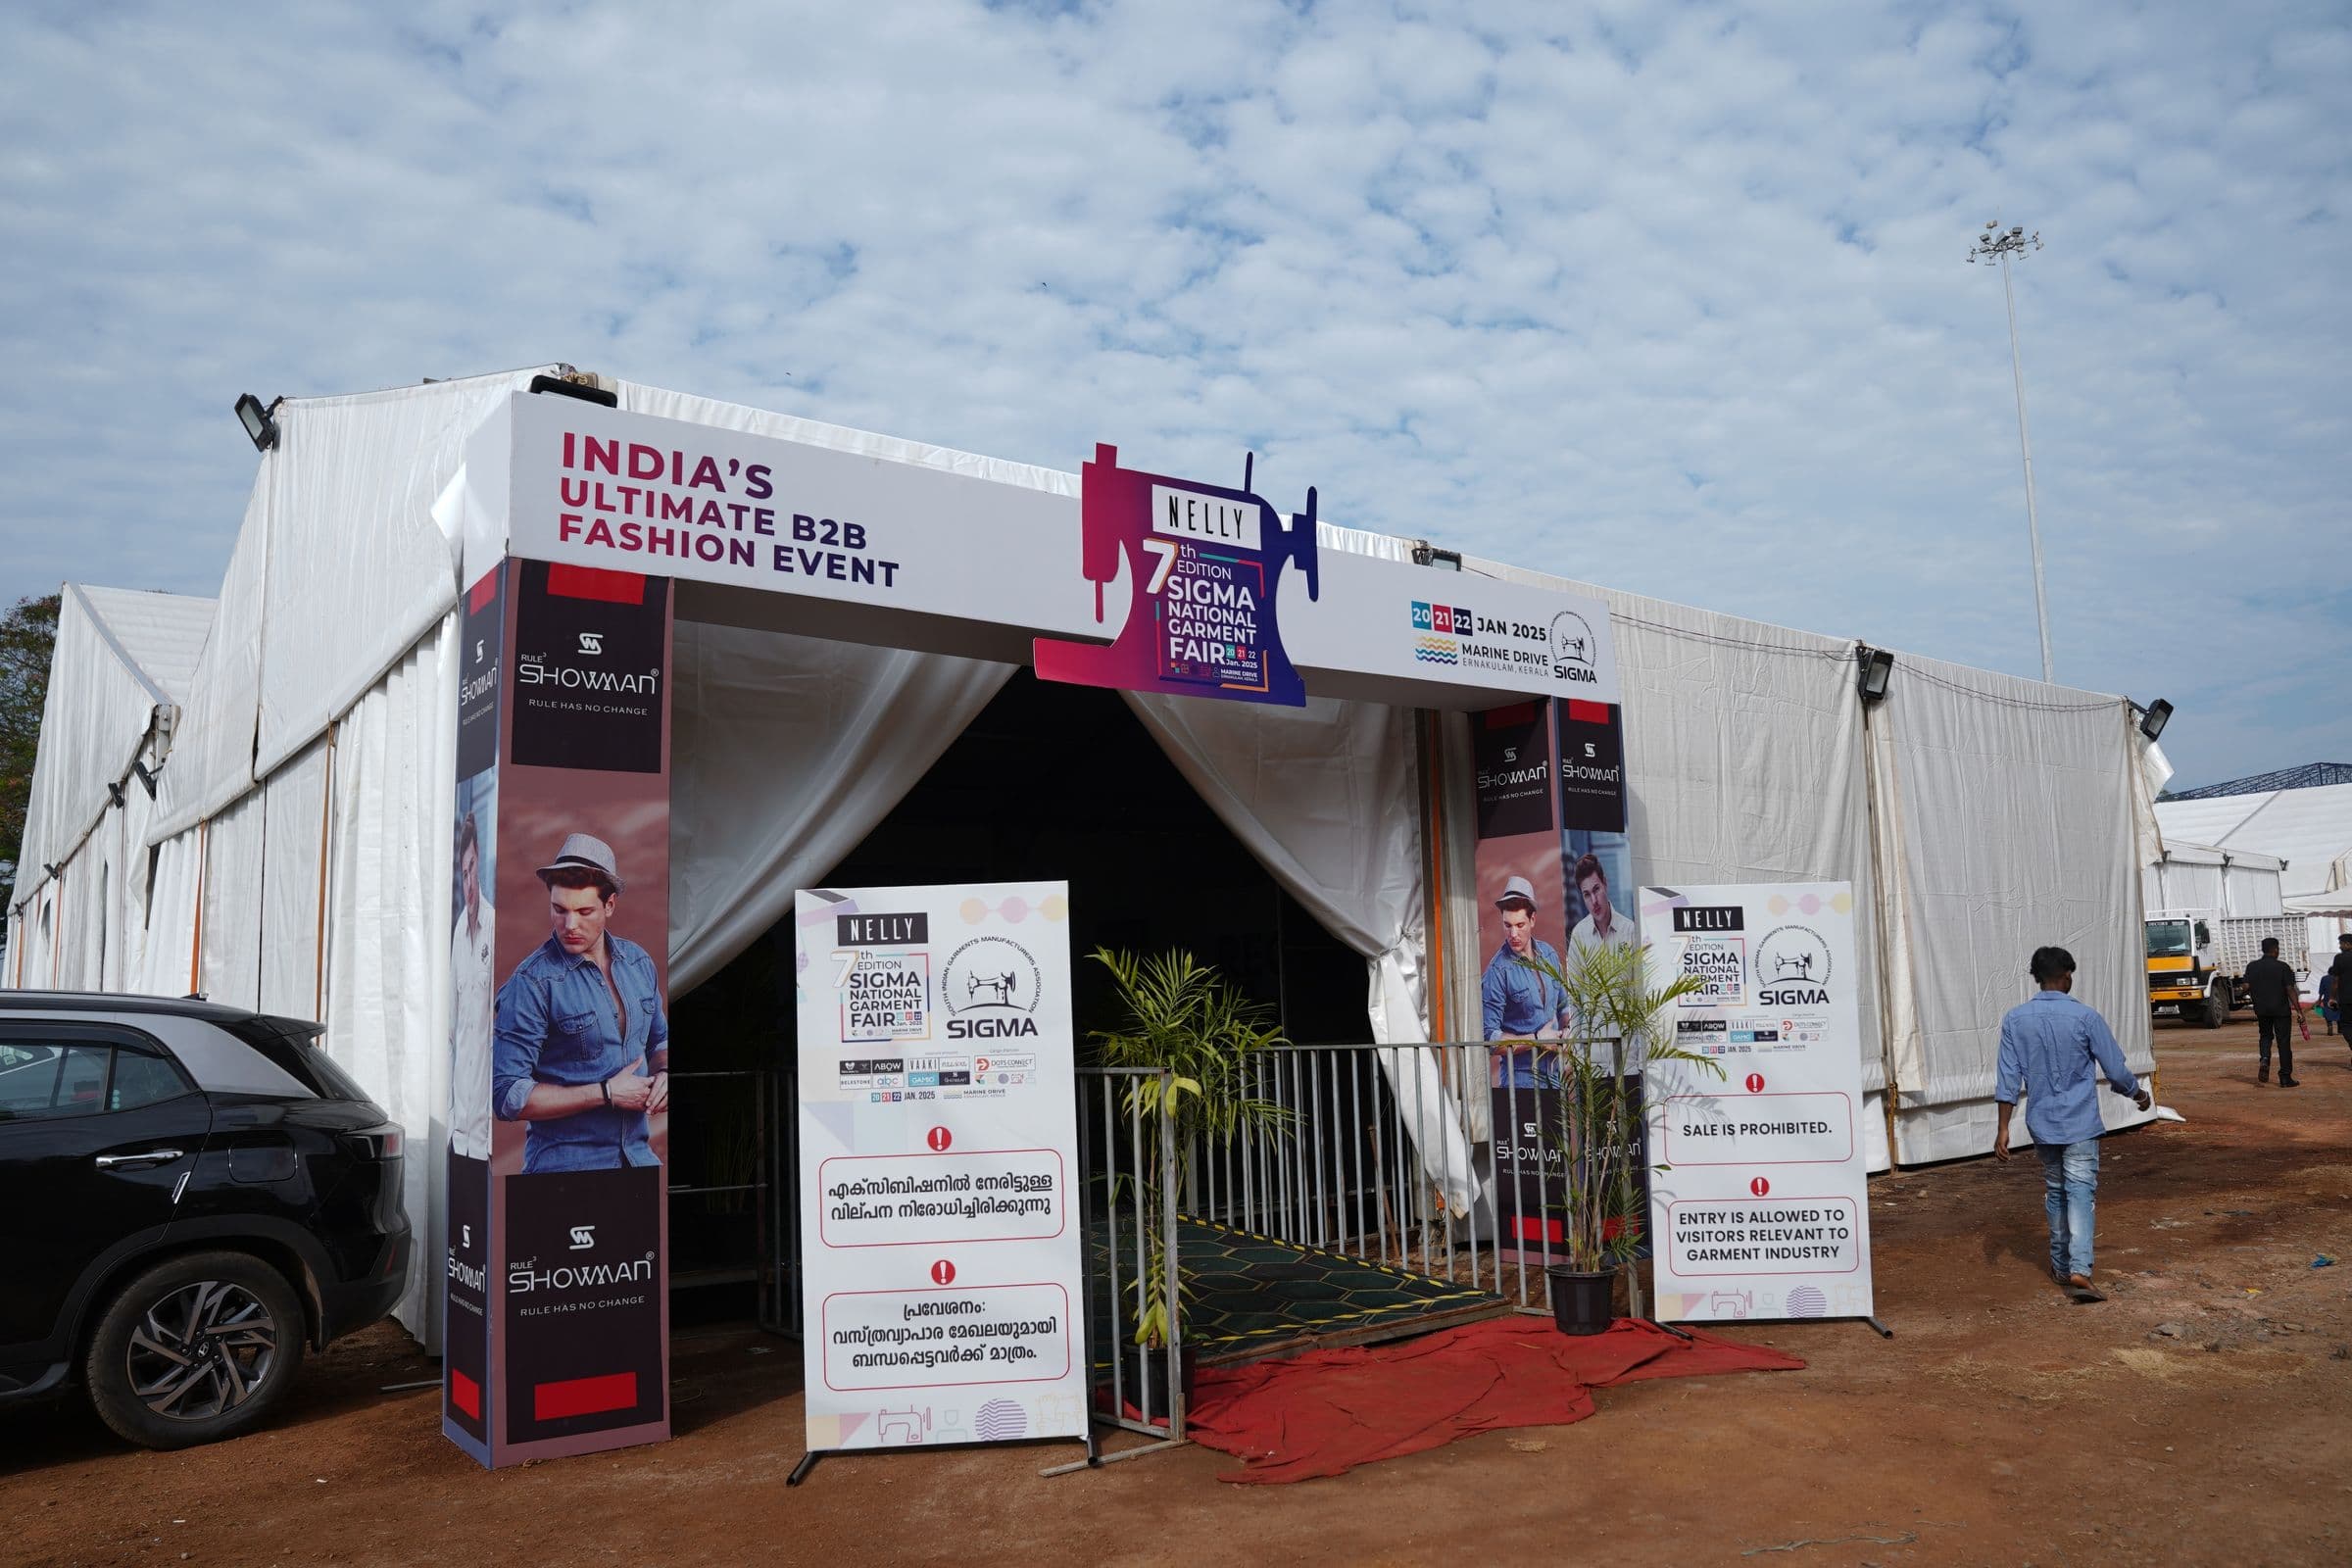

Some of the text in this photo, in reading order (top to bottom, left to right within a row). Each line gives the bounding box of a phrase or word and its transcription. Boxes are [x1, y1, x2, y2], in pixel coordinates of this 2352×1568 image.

[562, 431, 773, 500] INDIA'S
[560, 477, 868, 550] ULTIMATE B2B
[1168, 495, 1243, 539] NELLY
[559, 513, 900, 588] FASHION EVENT
[1177, 560, 1232, 581] EDITION
[1167, 575, 1256, 612] SIGMA
[1168, 601, 1256, 628] NATIONAL
[1168, 619, 1256, 645] GARMENT
[1412, 608, 1546, 642] 20 21 22 JAN 2025
[1170, 637, 1226, 665] FAIR
[1227, 648, 1256, 660] 20 21 22
[1462, 643, 1548, 666] MARINE DRIVE
[1518, 665, 1549, 677] KERALA
[1553, 664, 1597, 684] SIGMA
[528, 698, 649, 716] RULE HAS NO CHANGE
[1519, 788, 1544, 797] CHANGE
[1683, 909, 1732, 929] NELLY
[850, 917, 913, 943] NELLY
[948, 938, 979, 966] GARMENTS
[980, 936, 1036, 966] MANUFACTURERS
[1684, 952, 1740, 965] SIGMA
[858, 960, 902, 971] EDITION
[1684, 965, 1740, 974] NATIONAL
[850, 971, 922, 990] SIGMA
[1028, 966, 1042, 1013] ASSOCIATION
[1685, 983, 1720, 996] AIR
[850, 988, 922, 1000] NATIONAL
[943, 990, 956, 1016] SOUTH
[1759, 989, 1830, 1005] SIGMA
[850, 1000, 922, 1012] GARMENT
[851, 1011, 896, 1028] FAIR
[947, 1017, 1039, 1039] SIGMA
[909, 1059, 937, 1070] VAAKI
[918, 1091, 936, 1100] 2025
[1683, 1121, 1833, 1137] SALE IS PROHIBITED.
[975, 1172, 1053, 1193] നേരിട്ടുള്ള
[1679, 1208, 1845, 1225] ENTRY IS ALLOWED TO
[1676, 1227, 1849, 1243] VISITORS RELEVANT TO
[1687, 1246, 1839, 1261] GARMENT INDUSTRY
[520, 1295, 645, 1317] RULE HAS NO CHANGE
